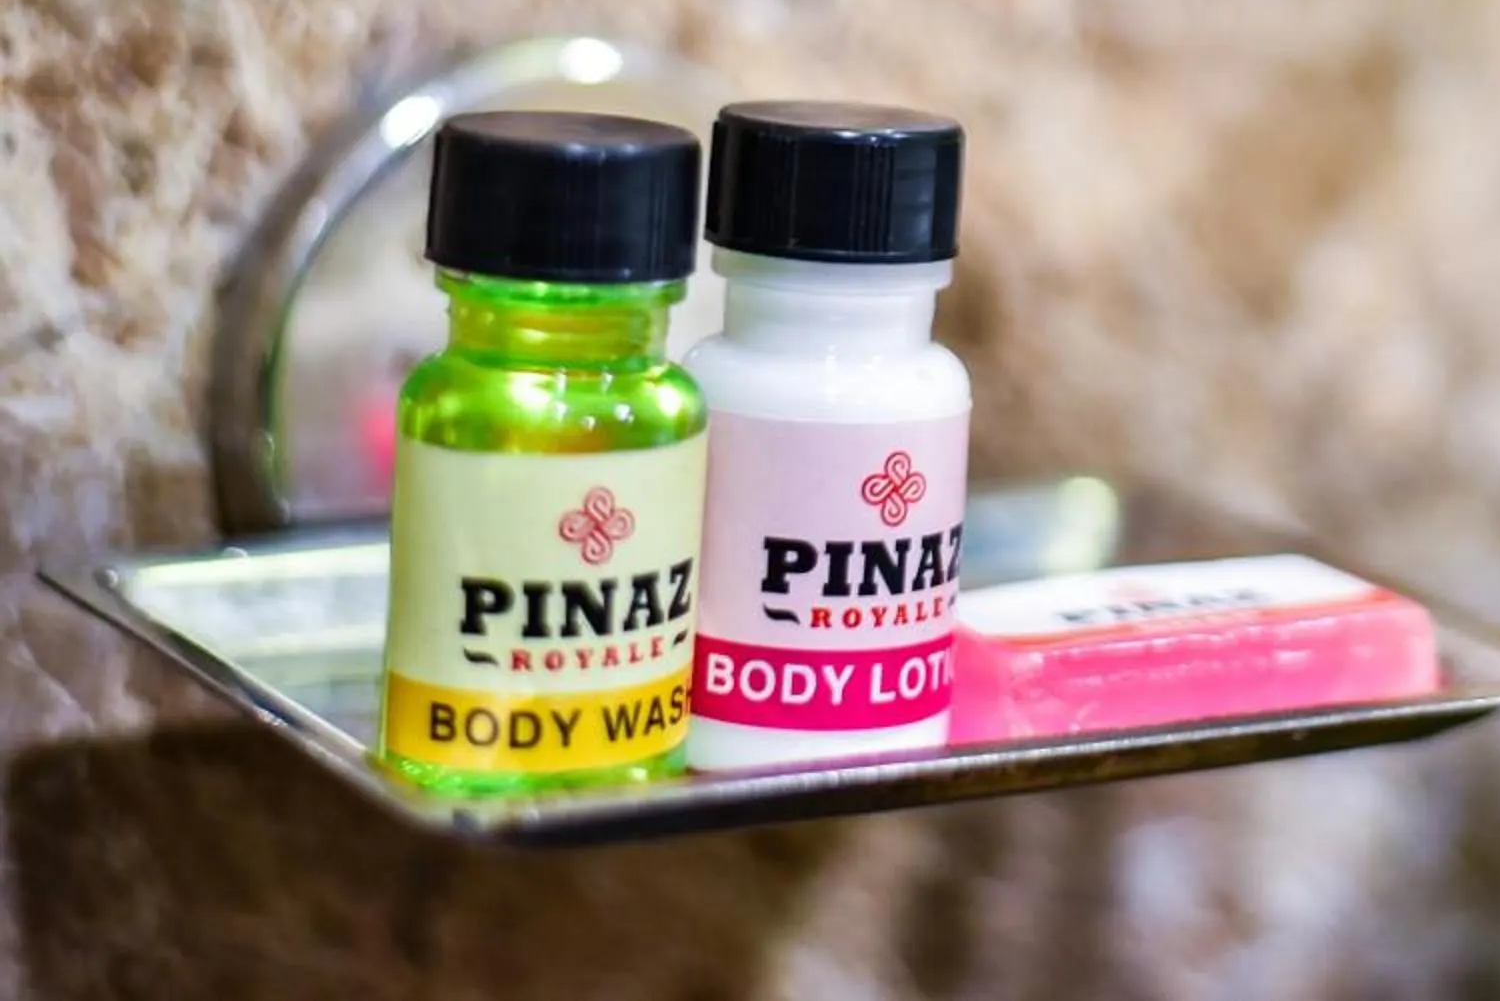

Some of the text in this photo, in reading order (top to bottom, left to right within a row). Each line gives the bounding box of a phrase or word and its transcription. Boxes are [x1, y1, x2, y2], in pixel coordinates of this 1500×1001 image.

[760, 524, 963, 597] PINAZ
[459, 557, 694, 640] PINAZ
[810, 596, 944, 628] ROYALE
[510, 635, 664, 670] ROYALE
[705, 648, 954, 706] BODY LOTI
[429, 700, 582, 750] BODY
